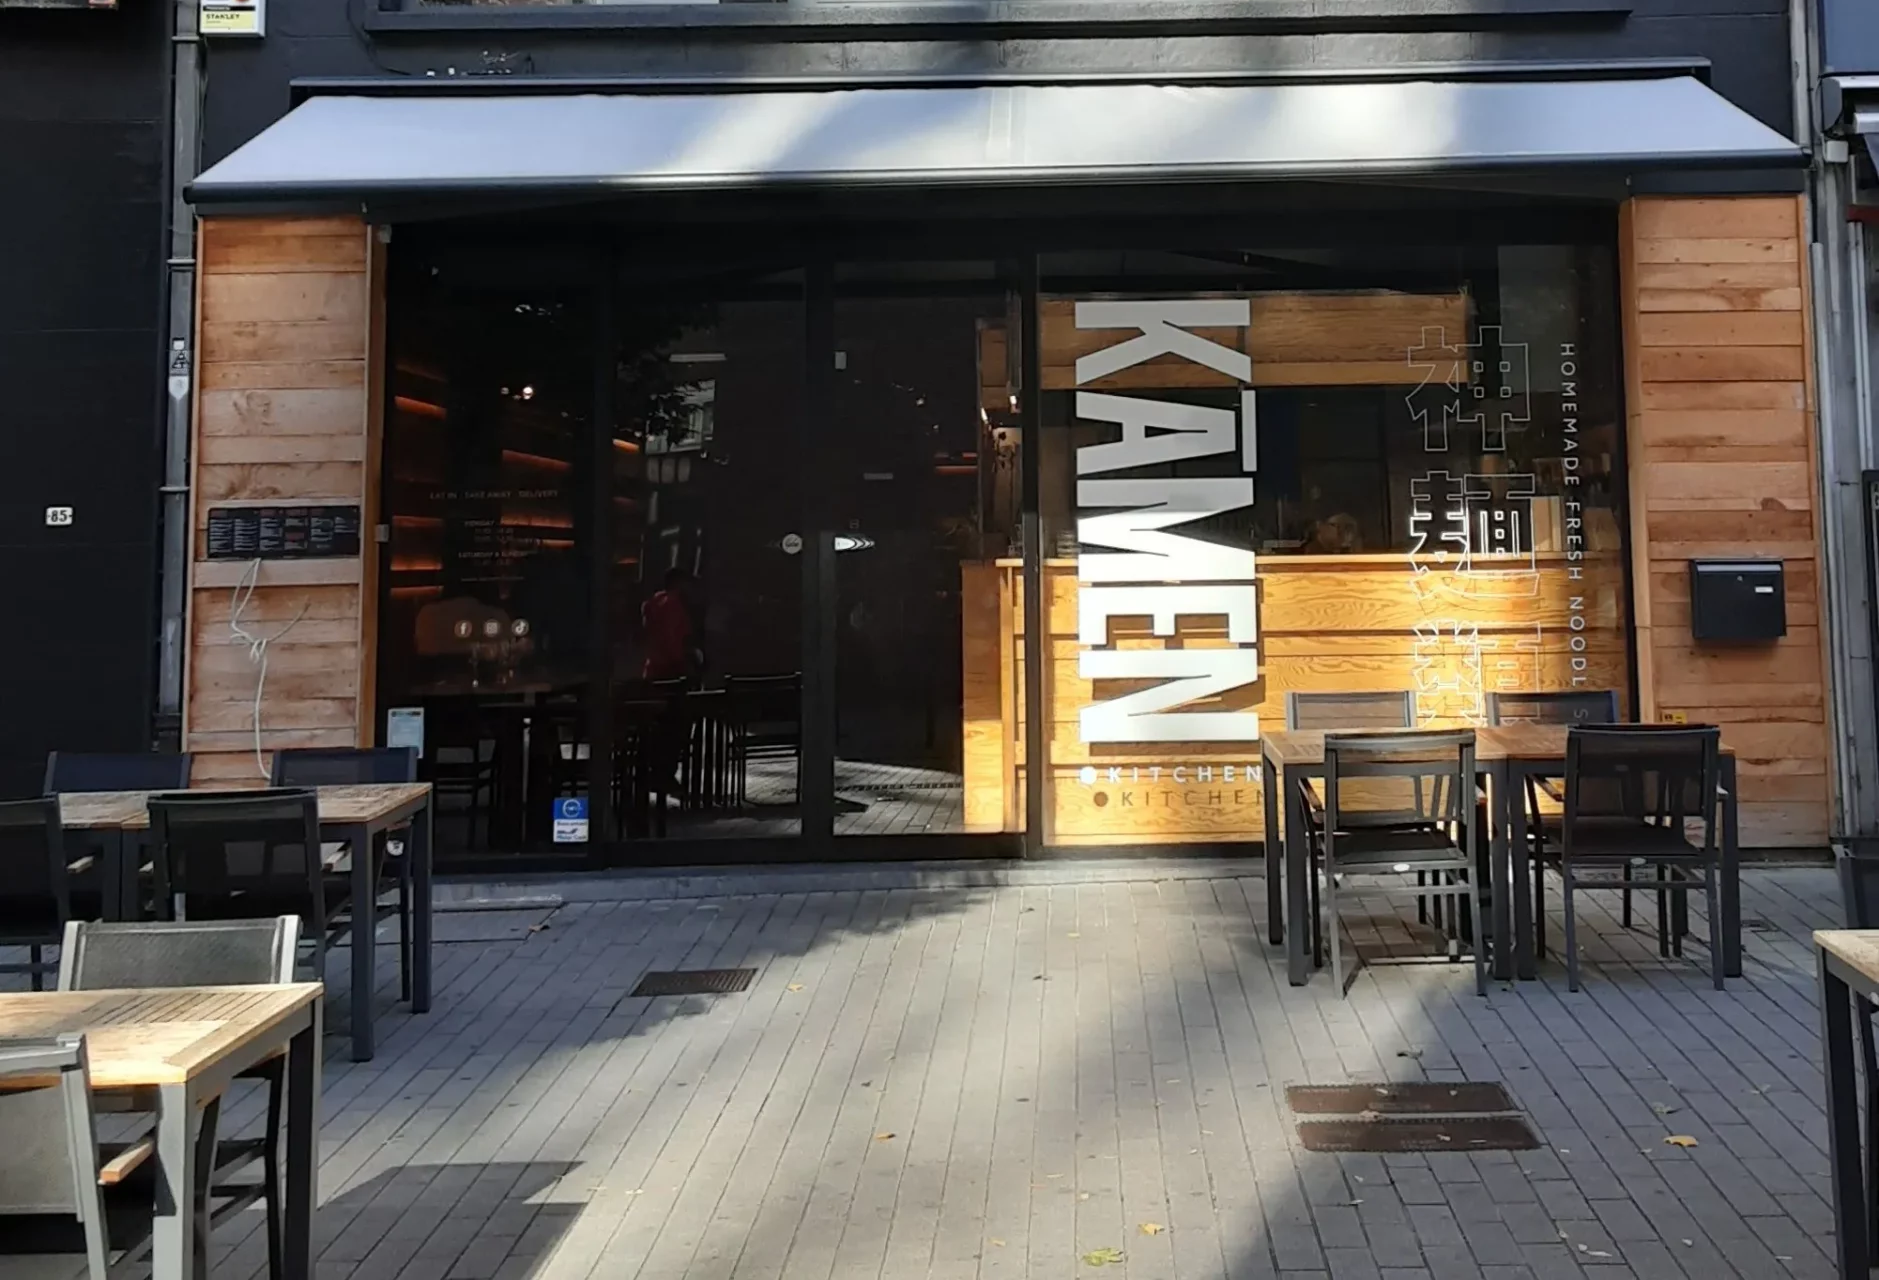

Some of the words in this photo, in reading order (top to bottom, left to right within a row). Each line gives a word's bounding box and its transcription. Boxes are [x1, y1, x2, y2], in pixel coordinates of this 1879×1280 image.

[1561, 343, 1580, 485] HOMEMADE
[51, 510, 67, 522] 85
[1567, 502, 1583, 579] FRESH
[1570, 596, 1588, 718] NOODLS
[1108, 765, 1261, 783] KITCHEN
